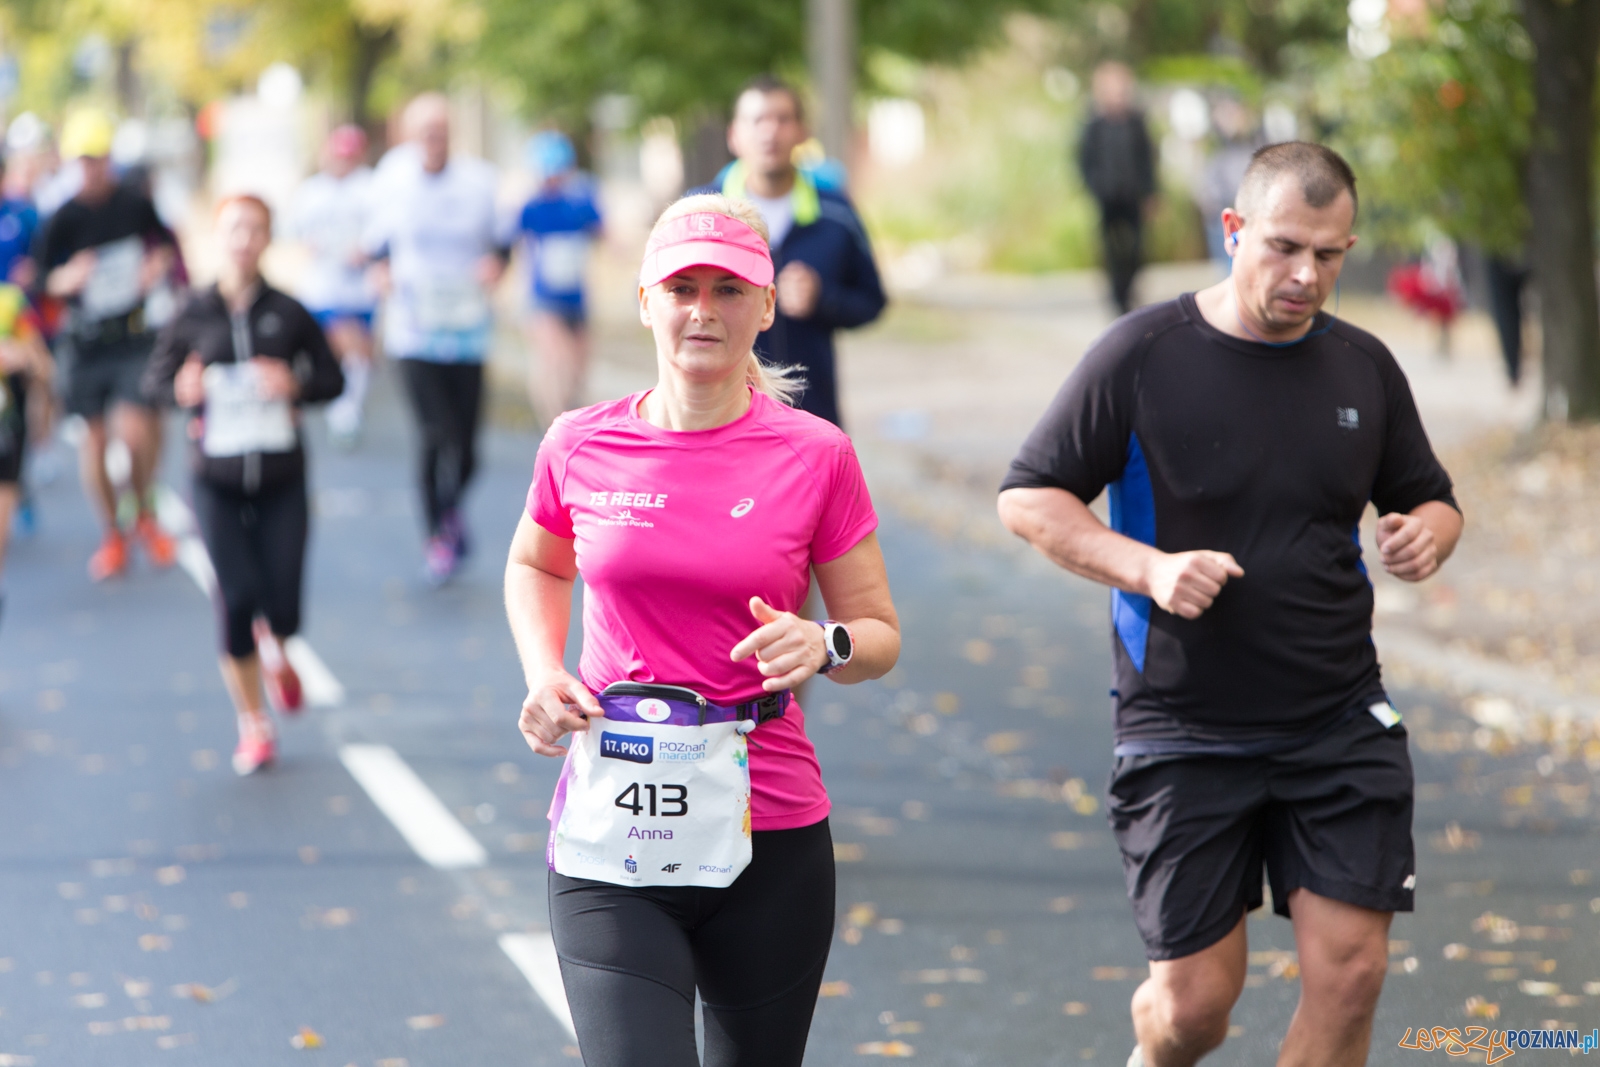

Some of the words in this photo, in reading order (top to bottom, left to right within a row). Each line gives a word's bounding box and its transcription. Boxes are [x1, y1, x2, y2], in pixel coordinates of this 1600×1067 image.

[589, 492, 608, 506] TS
[604, 739, 649, 756] 17.PKO
[659, 751, 705, 761] maraton
[614, 782, 688, 817] 413
[627, 826, 673, 840] Anna
[661, 863, 682, 873] 4F
